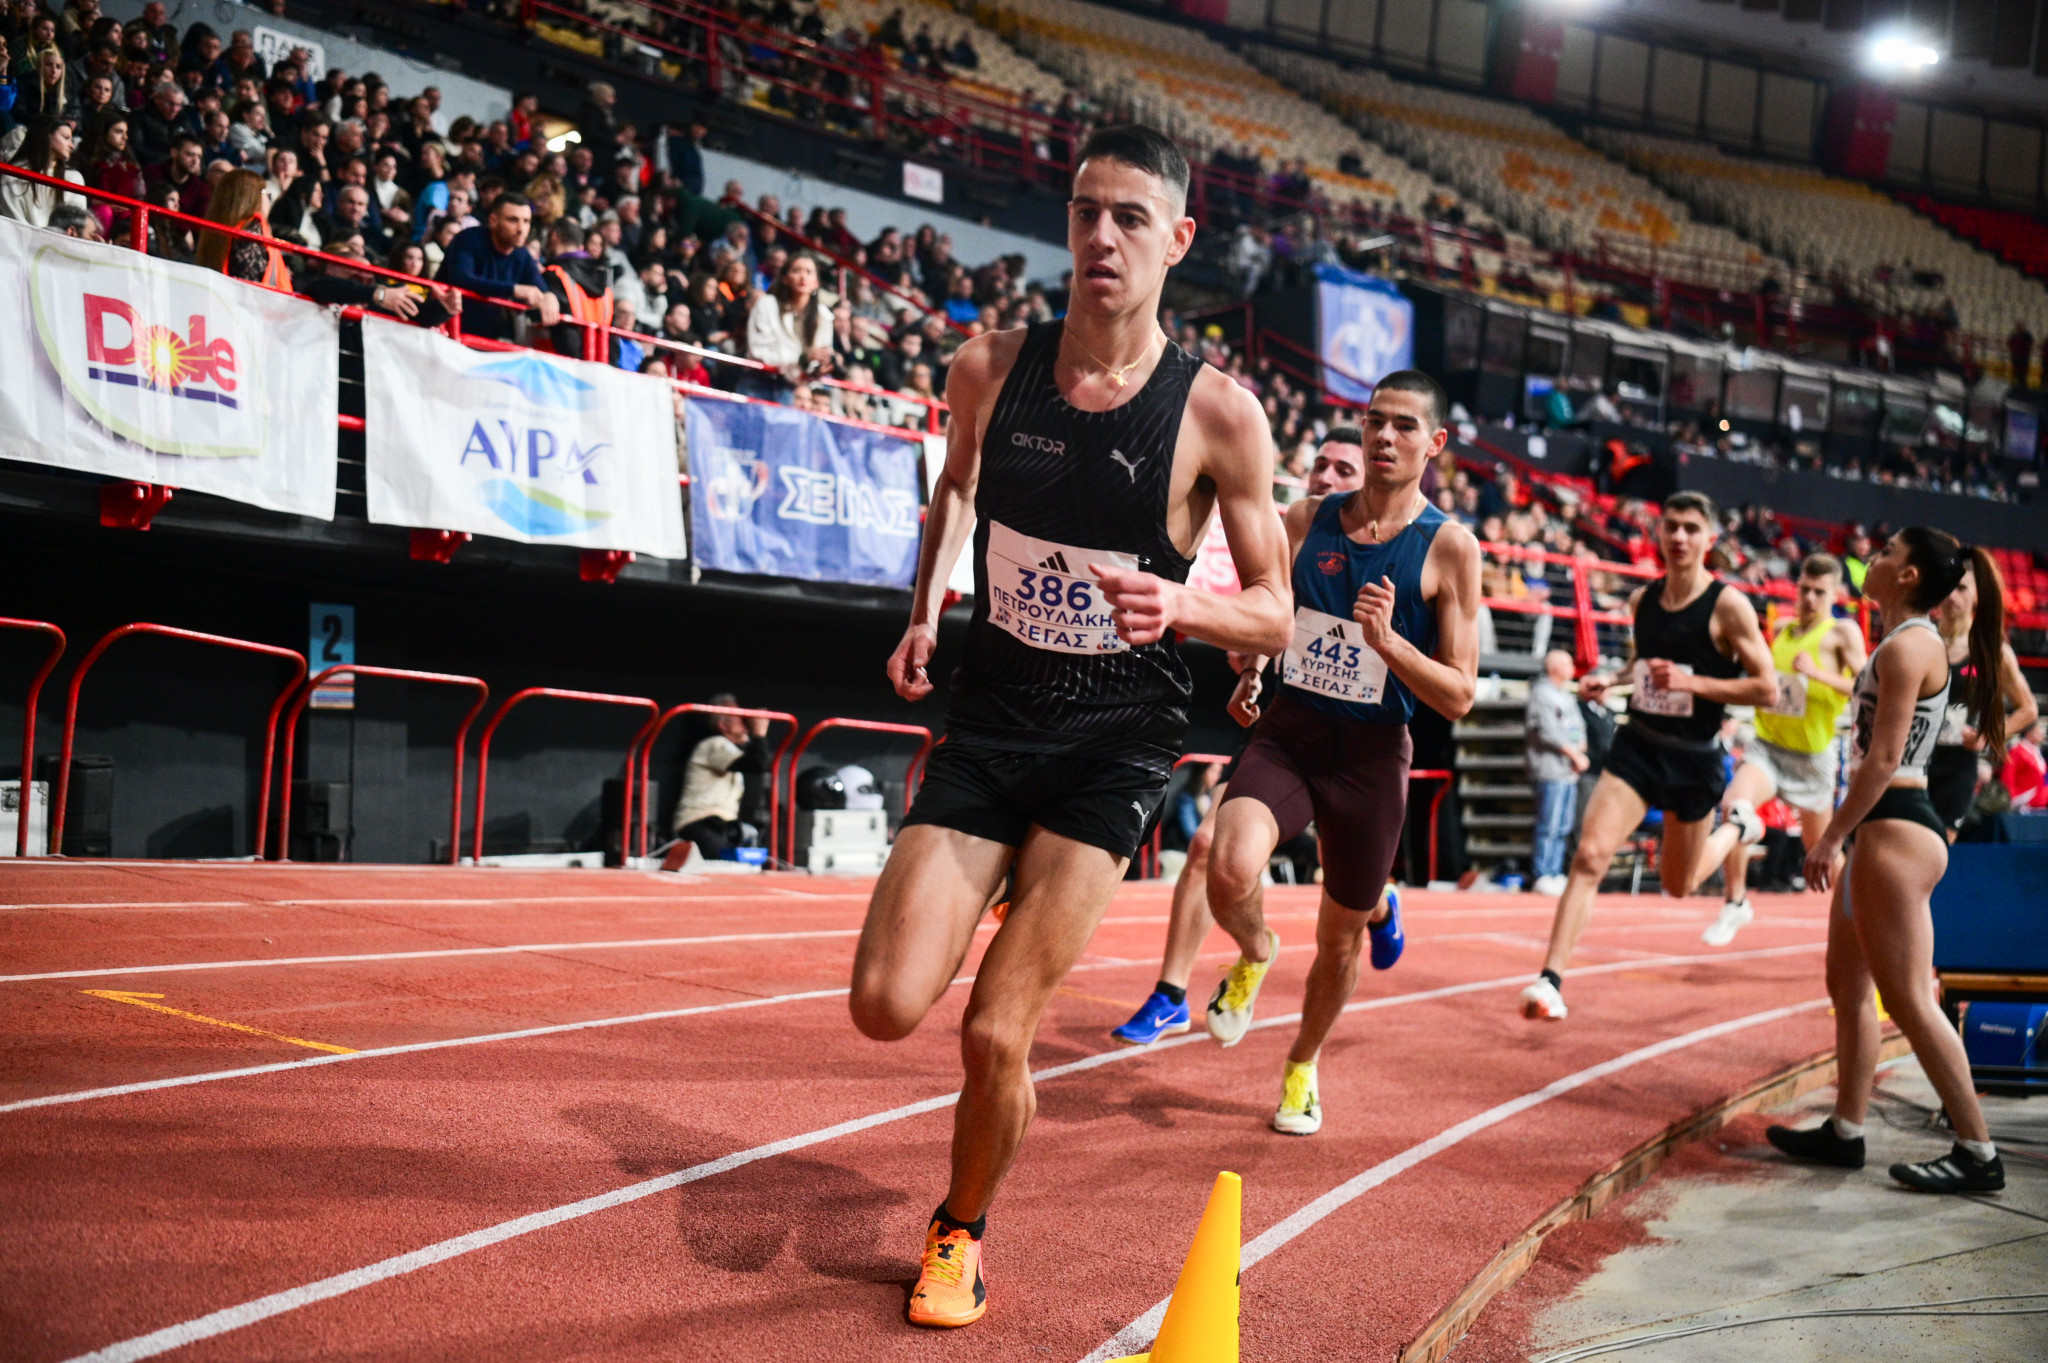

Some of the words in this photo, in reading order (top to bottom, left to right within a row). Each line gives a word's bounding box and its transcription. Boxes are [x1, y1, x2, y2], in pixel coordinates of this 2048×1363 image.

[83, 292, 240, 392] Dole
[993, 585, 1118, 628] ΠΕΤΡΟΥΛΑΚΗ
[1015, 567, 1092, 612] 386
[323, 614, 342, 662] 2
[1016, 618, 1088, 649] ΣΕΓΑΣ
[1306, 636, 1362, 669] 443
[1301, 656, 1361, 681] ΚΥΡΤΣΗΣ
[1301, 672, 1353, 696] ΣΕΓΑΣ
